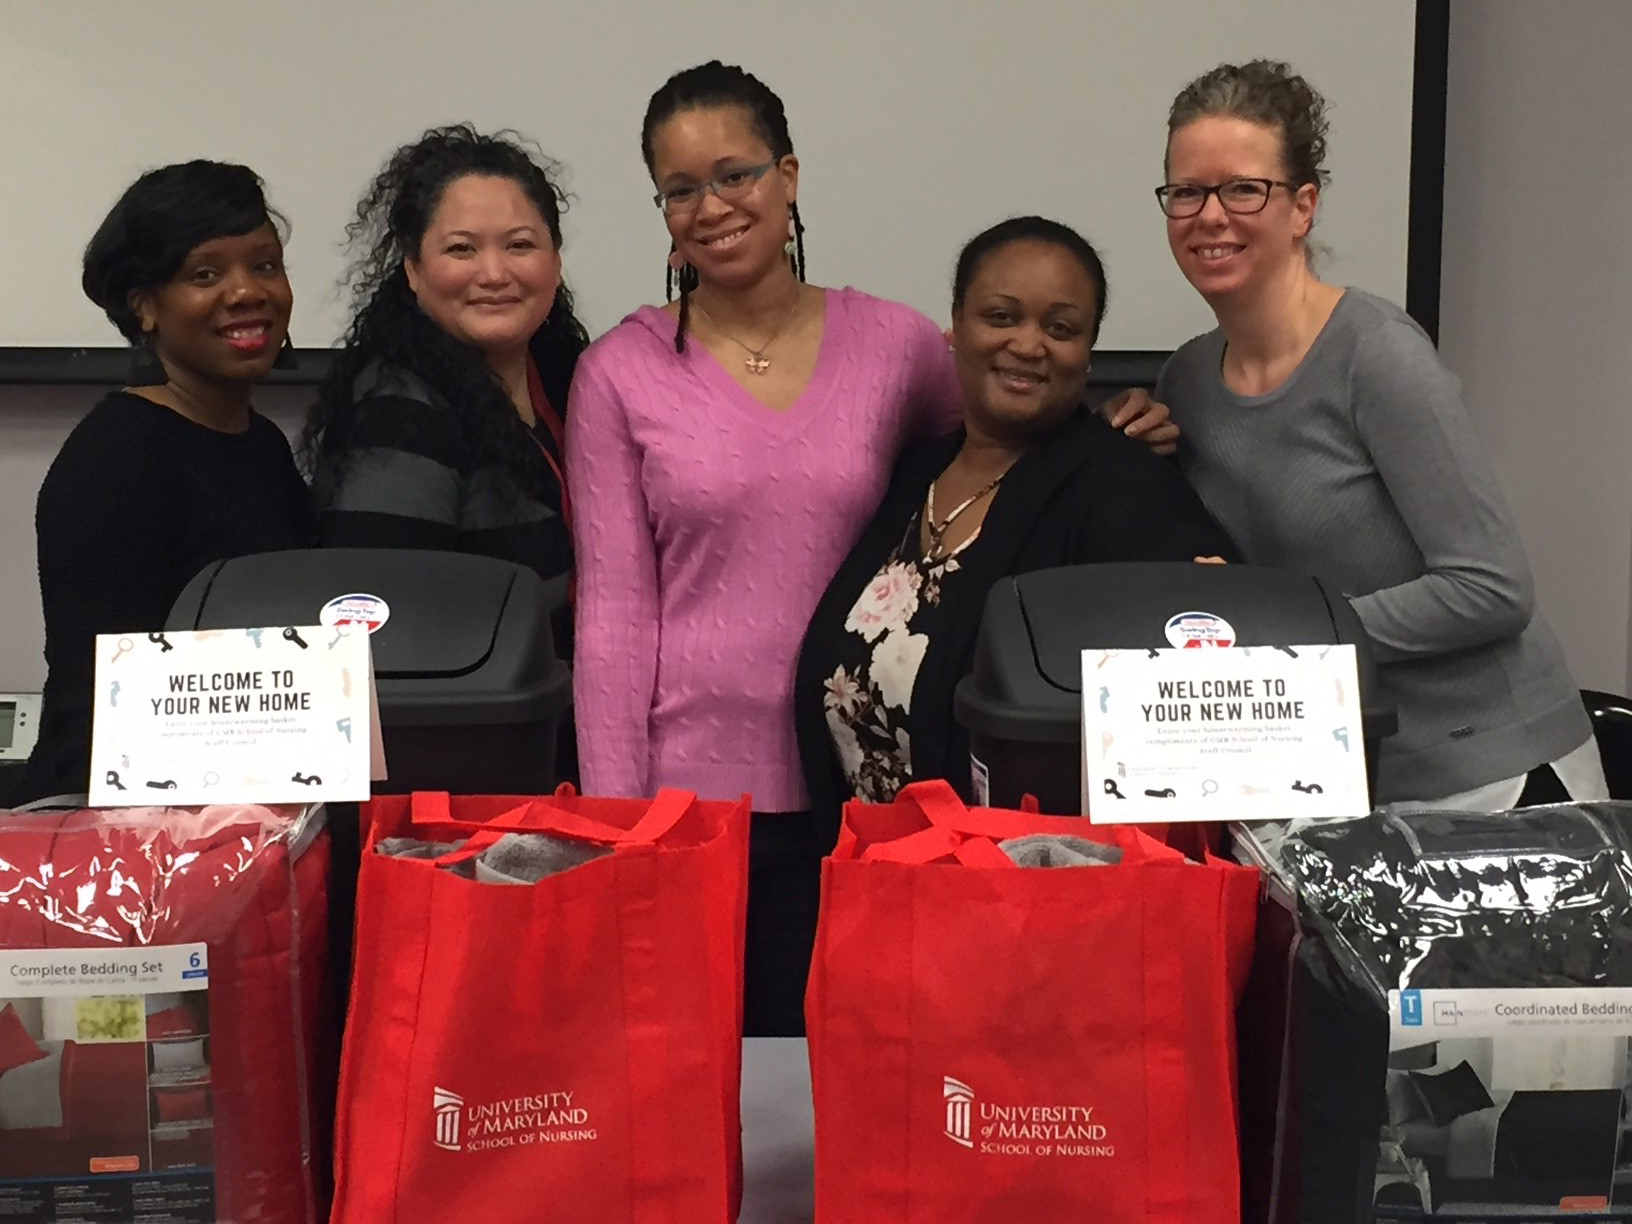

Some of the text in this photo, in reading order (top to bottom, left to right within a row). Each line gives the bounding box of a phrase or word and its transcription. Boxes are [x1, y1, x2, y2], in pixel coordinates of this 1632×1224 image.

[169, 670, 294, 693] WELCOME TO
[1158, 678, 1286, 700] WELCOME TO
[151, 691, 311, 716] YOUR NEW HOME
[1141, 701, 1305, 722] YOUR NEW HOME
[10, 961, 163, 979] Complete Bedding Set
[189, 952, 200, 968] 6
[1403, 995, 1417, 1013] T
[1495, 1003, 1577, 1017] Coordinated
[468, 1091, 574, 1122] UNIVERSITY
[980, 1103, 1093, 1123] UNIVERSITY
[467, 1108, 588, 1138] of MARYLAND
[981, 1122, 1107, 1141] of MARYLAND
[467, 1128, 598, 1152] SCHOOL OF NURSING
[980, 1142, 1115, 1157] SCHOOL OF NURSING
